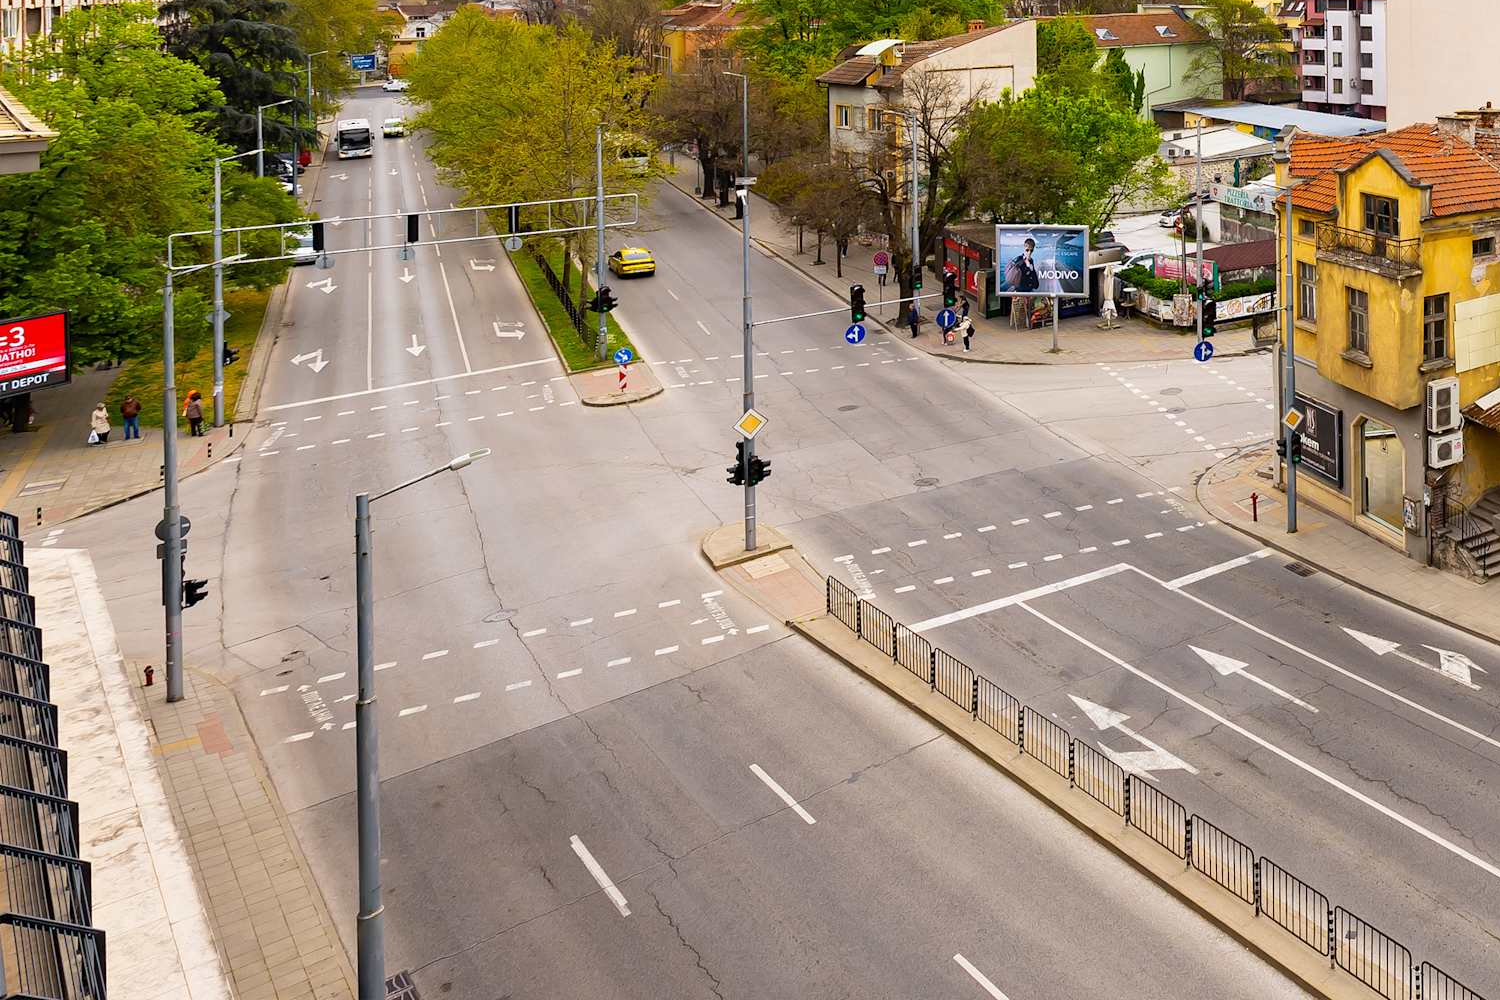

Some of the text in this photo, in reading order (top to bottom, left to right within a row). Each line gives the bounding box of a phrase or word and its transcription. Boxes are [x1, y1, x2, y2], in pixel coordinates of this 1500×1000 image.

[1227, 188, 1249, 199] PIZZERIA
[1225, 195, 1254, 208] TRATTORIA
[1038, 270, 1079, 280] MODIVO
[0, 347, 36, 362] АТНО!
[11, 373, 50, 390] DEPOT
